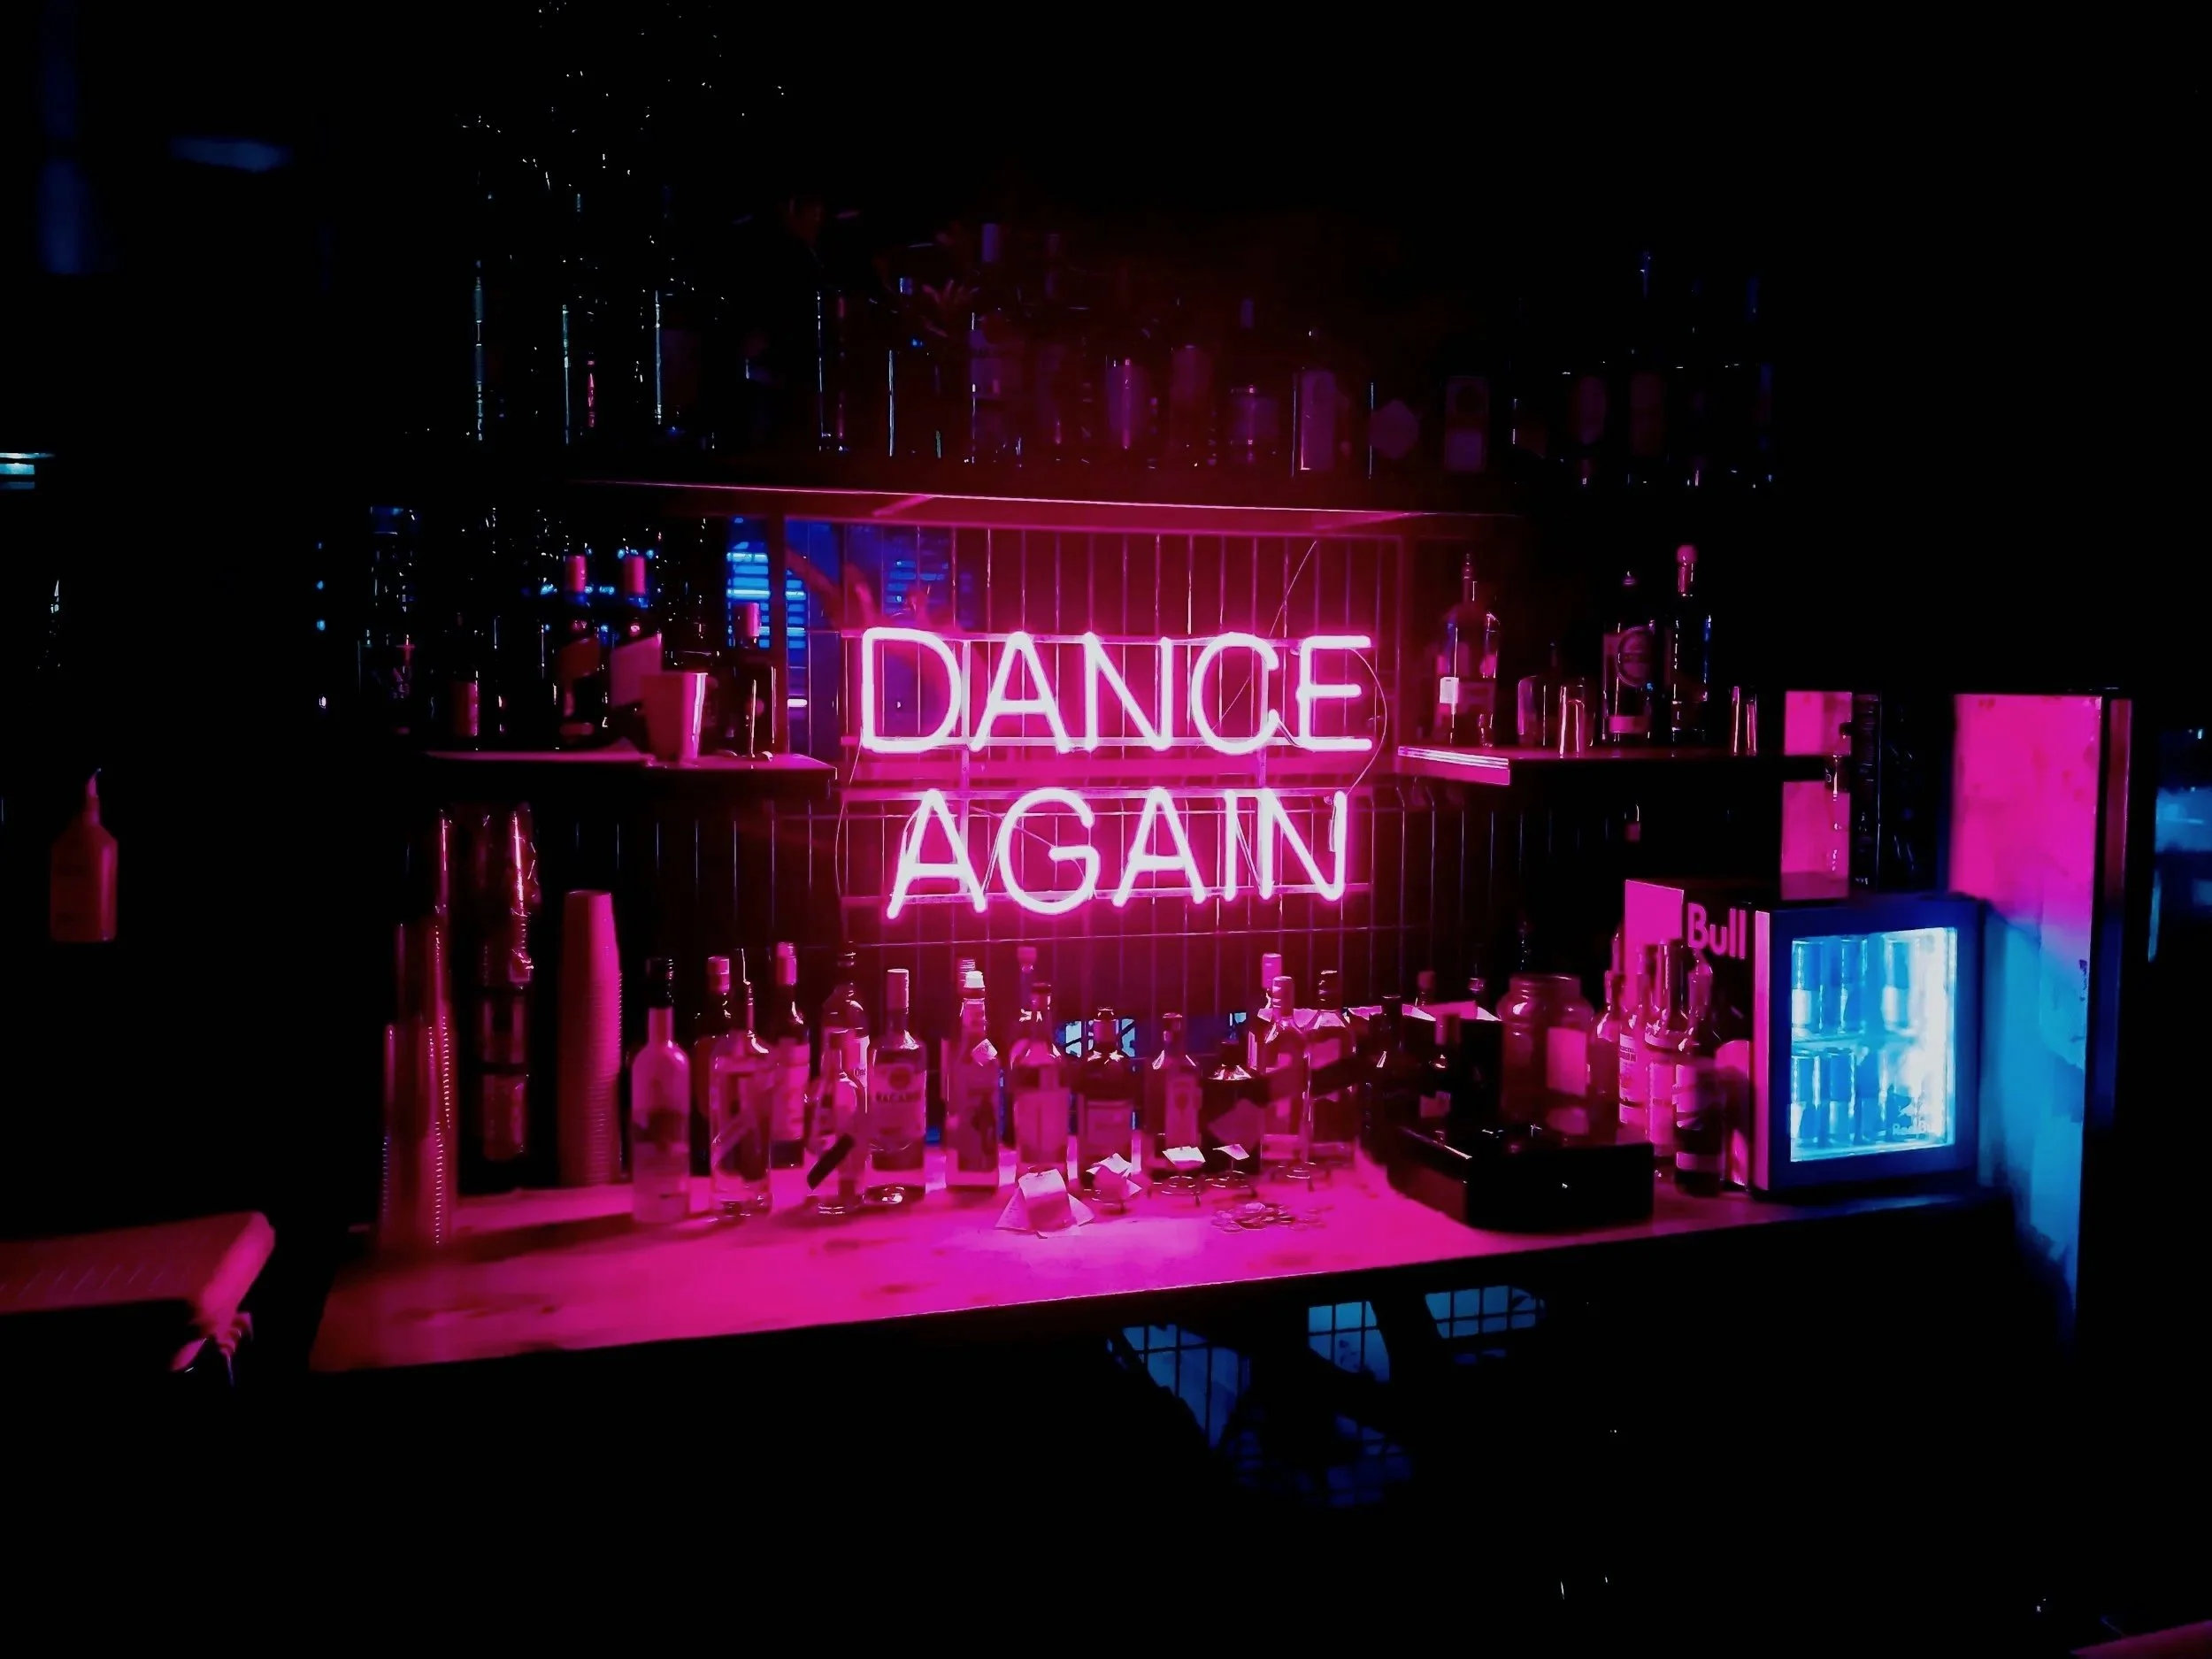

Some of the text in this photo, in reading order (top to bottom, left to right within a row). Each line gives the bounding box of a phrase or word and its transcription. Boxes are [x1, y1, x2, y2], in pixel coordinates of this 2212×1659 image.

[862, 627, 1372, 755] DANCE
[887, 787, 1348, 919] AGAIN
[1687, 902, 1747, 959] Bull
